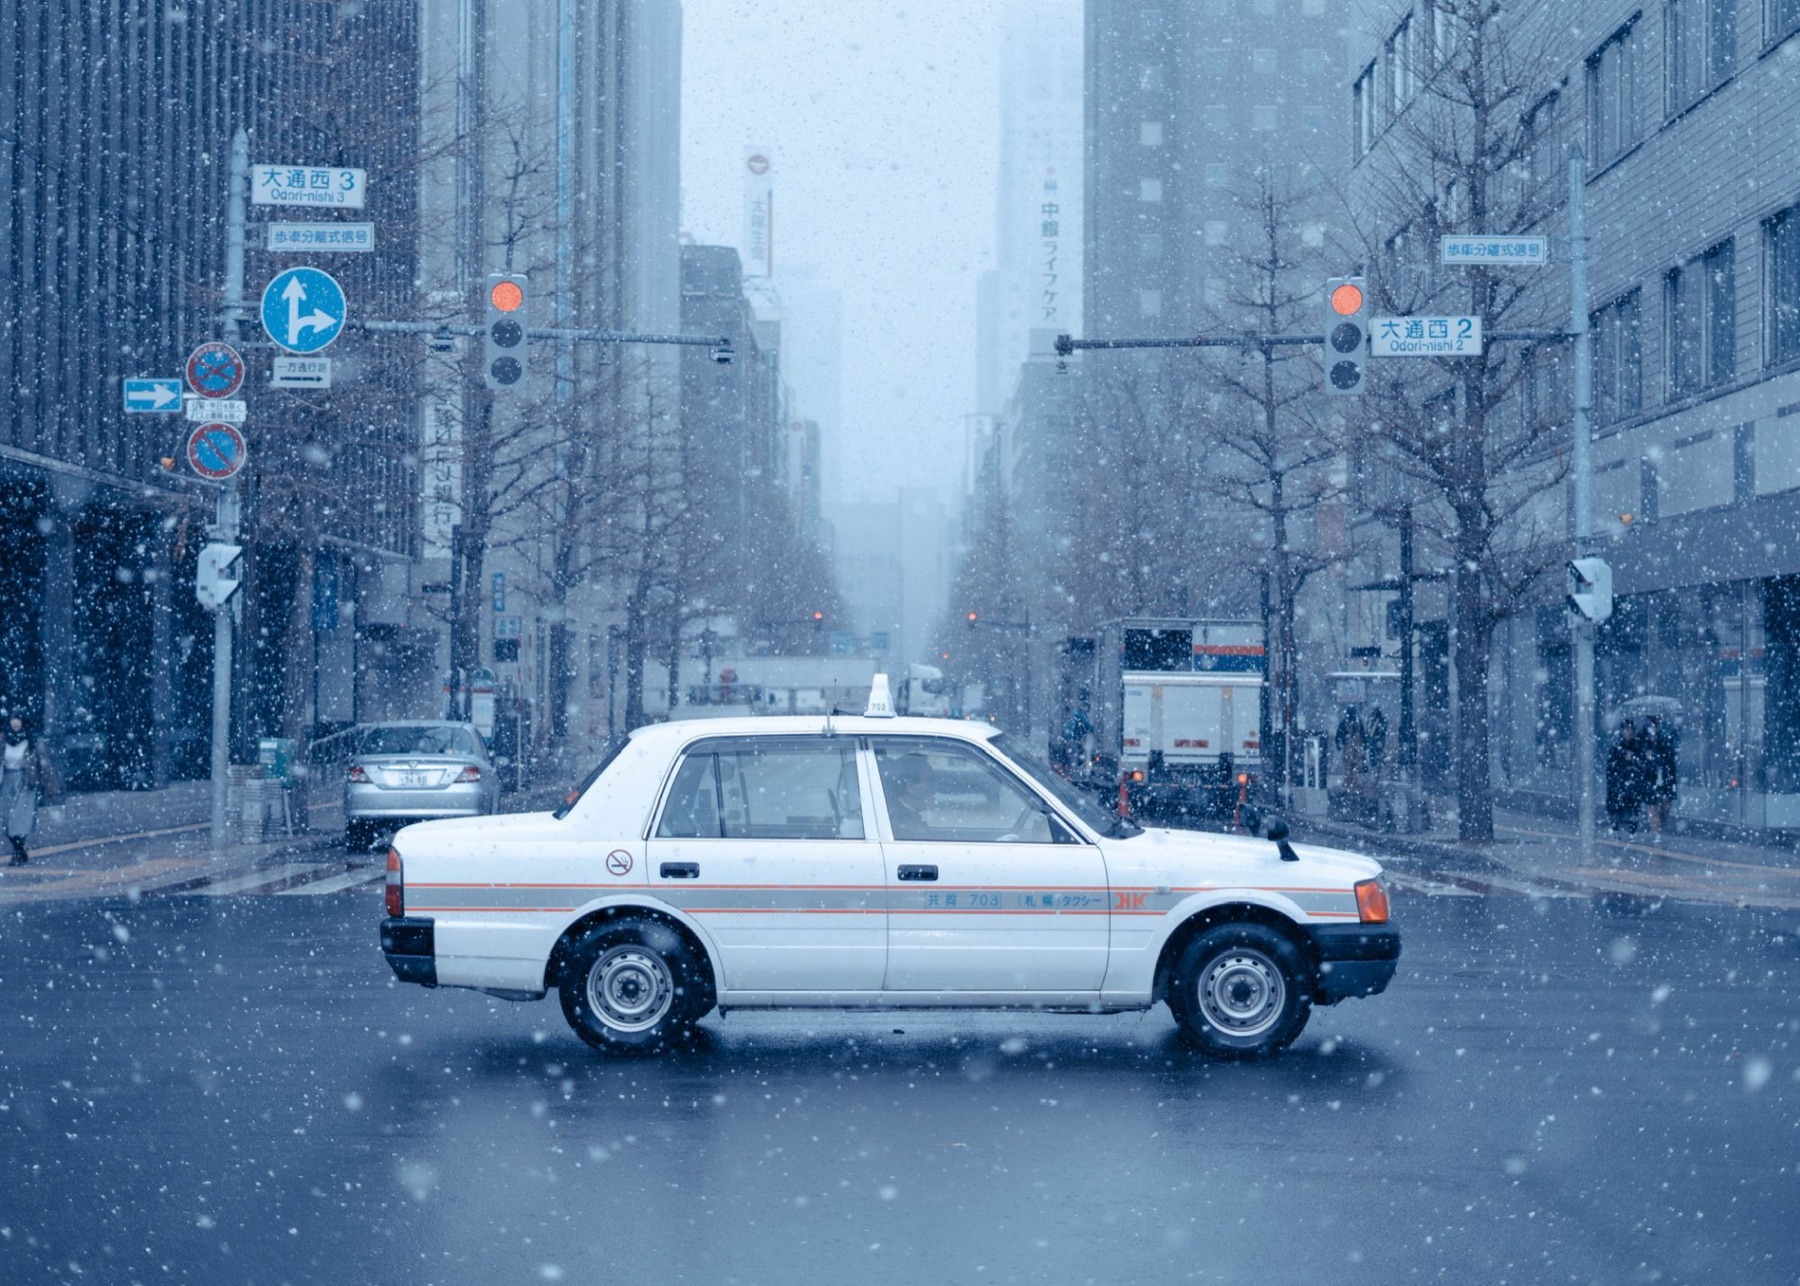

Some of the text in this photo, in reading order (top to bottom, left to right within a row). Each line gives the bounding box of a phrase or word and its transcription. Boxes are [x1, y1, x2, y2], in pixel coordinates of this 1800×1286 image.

[262, 168, 355, 190] 大通西 3
[271, 188, 345, 203] Odori-nishi 3
[274, 229, 368, 244] 歩車分離式信号
[1447, 243, 1540, 257] 歩車分離式信号
[1380, 318, 1472, 339] 大通西 2
[1390, 340, 1463, 351] Odori-nishi 2
[871, 703, 886, 711] 703
[971, 894, 999, 906] 703
